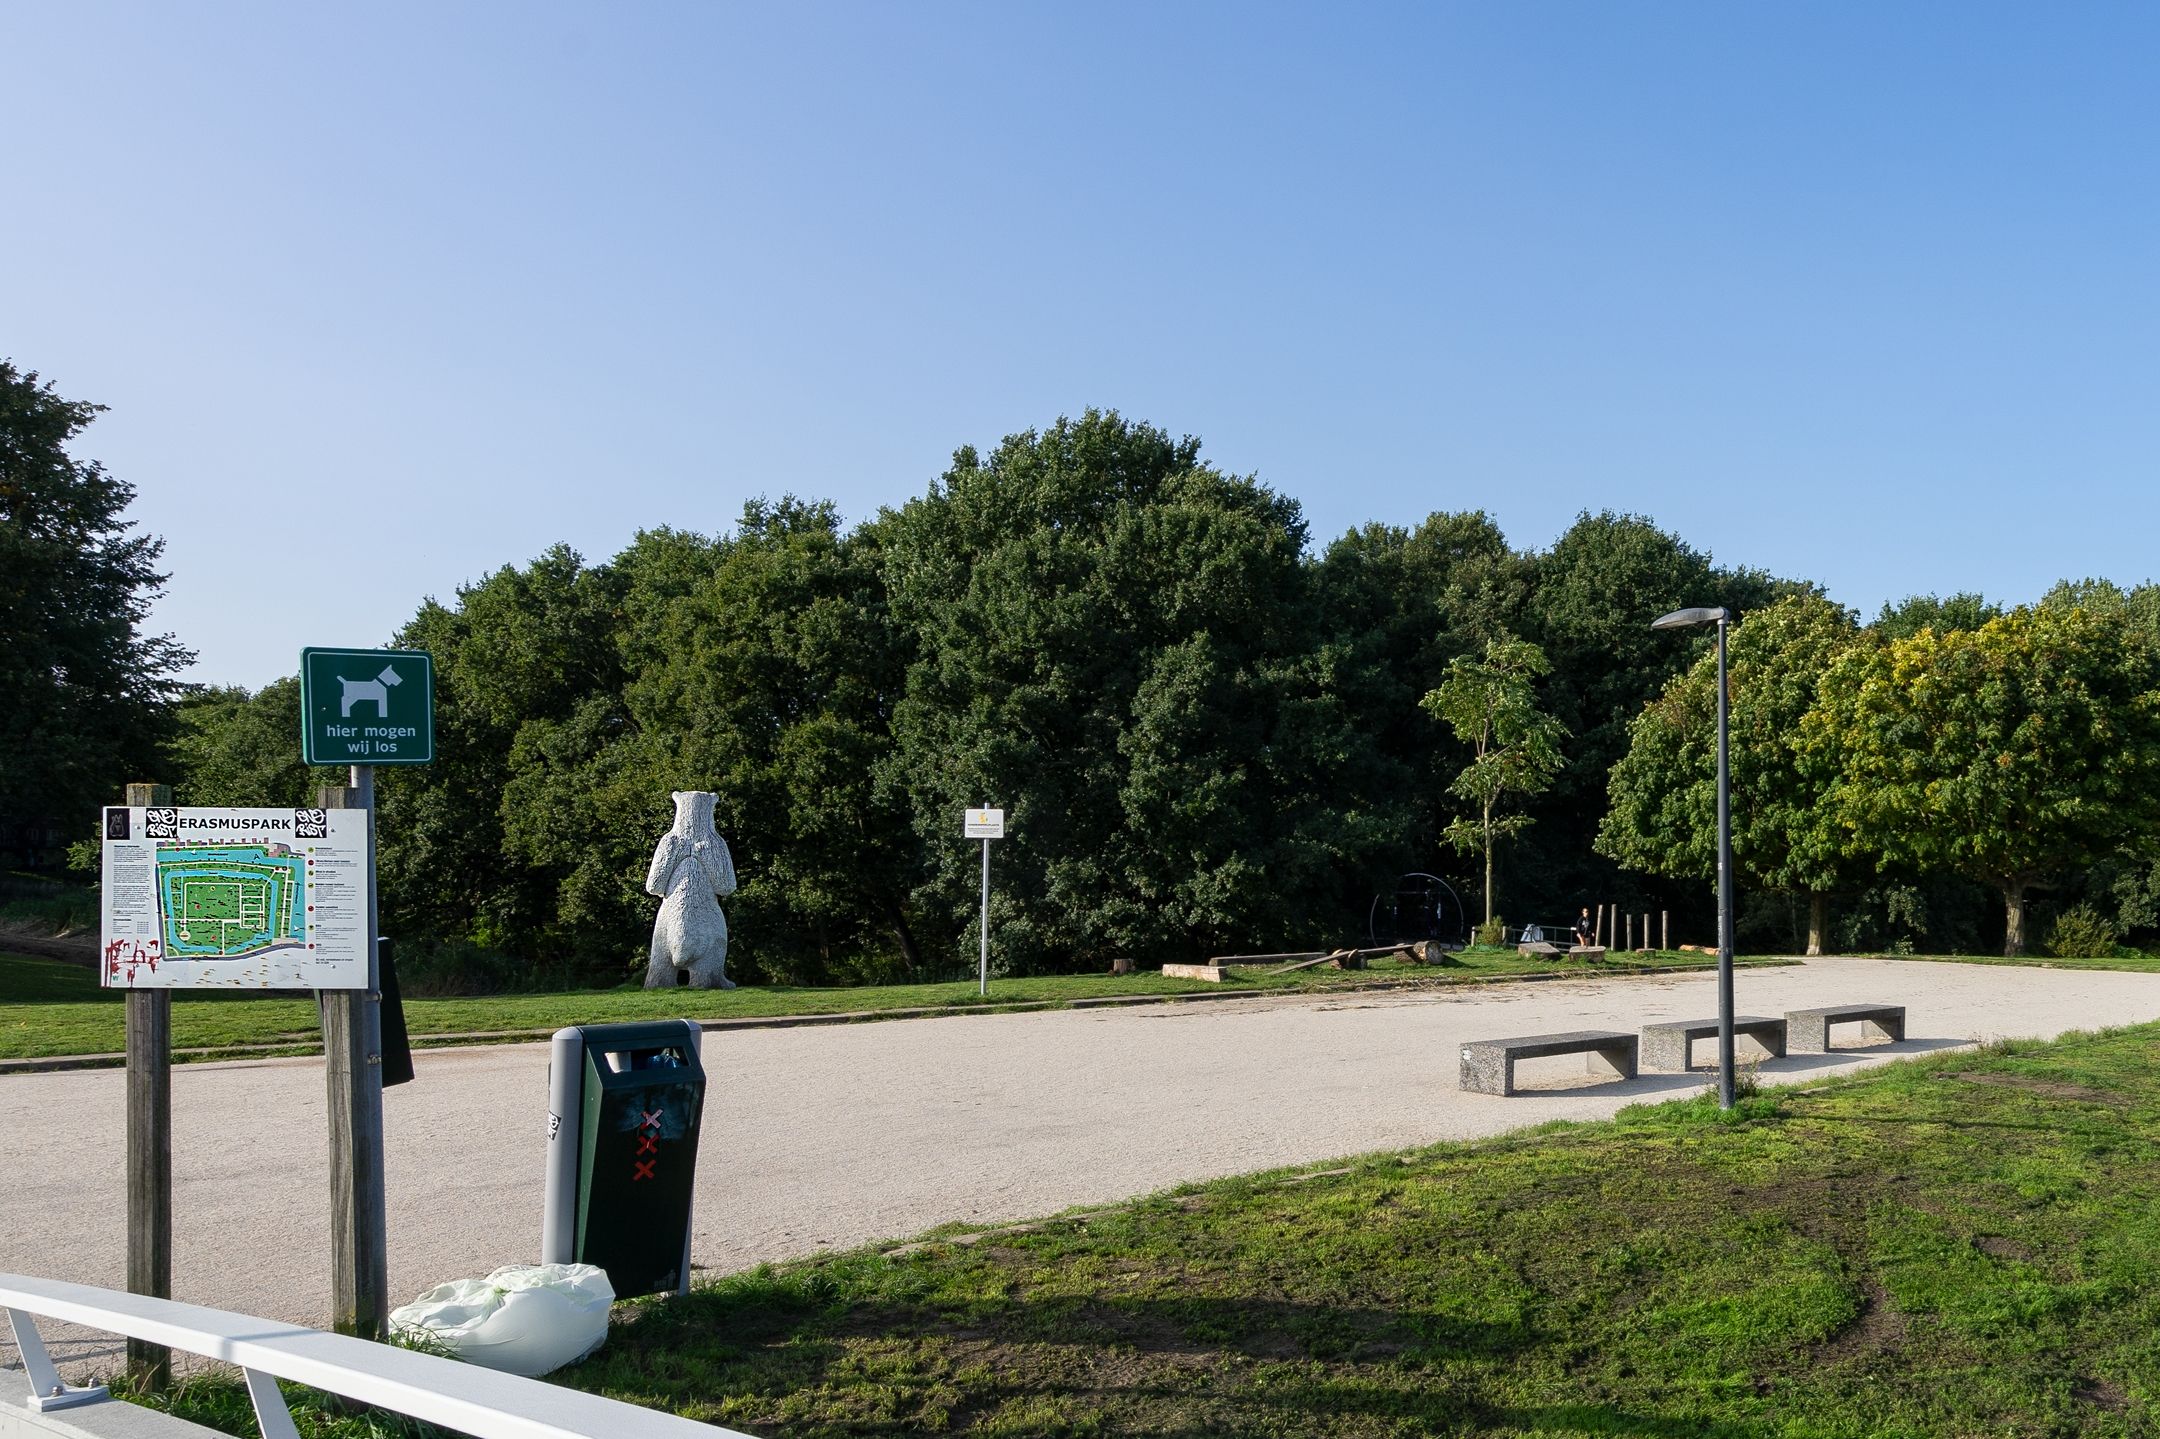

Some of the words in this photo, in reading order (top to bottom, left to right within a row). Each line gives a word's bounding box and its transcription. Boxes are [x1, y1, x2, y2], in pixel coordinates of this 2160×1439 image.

[326, 724, 358, 737] hier
[364, 726, 416, 739] mogen
[347, 740, 370, 755] wij
[375, 740, 398, 753] los
[179, 818, 291, 830] ERASMUSPARK
